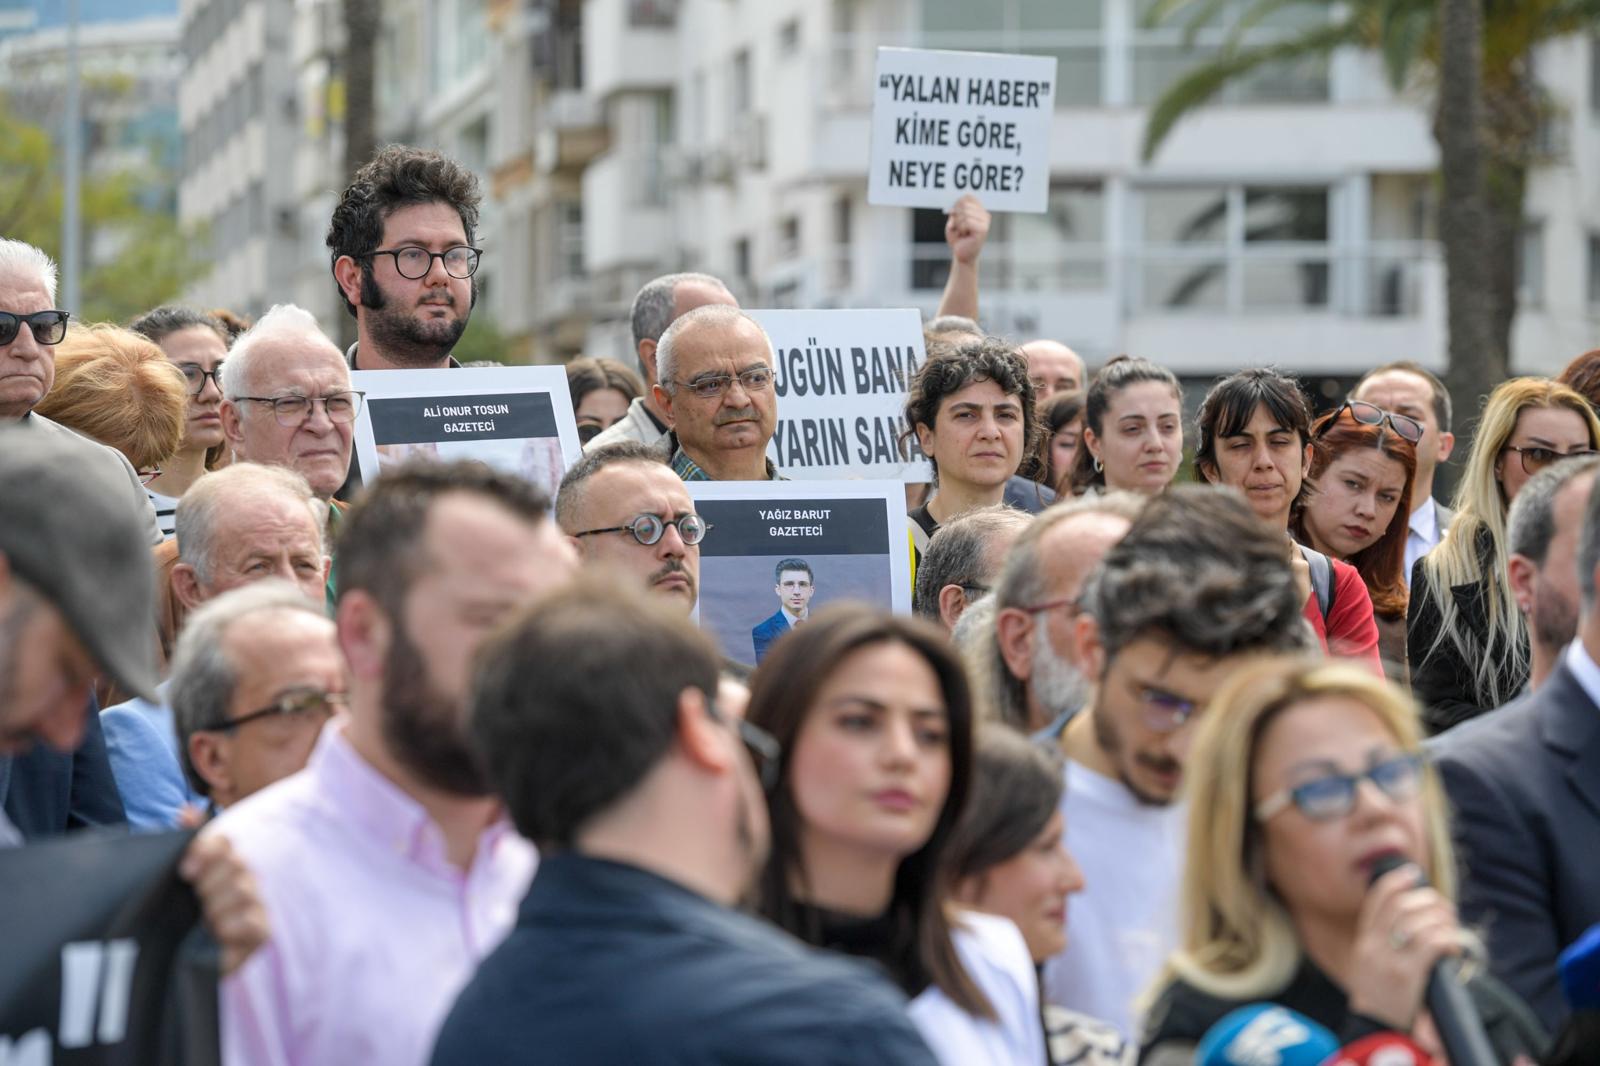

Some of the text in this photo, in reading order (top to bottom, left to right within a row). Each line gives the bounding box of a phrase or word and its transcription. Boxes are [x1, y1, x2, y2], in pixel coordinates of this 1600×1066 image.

[896, 111, 1022, 156] KİME GÖRE,
[889, 157, 1024, 192] NEYE GÖRE?
[775, 337, 846, 397] UGÜN
[423, 404, 509, 418] ALİ ONUR TOSUN
[443, 419, 495, 433] GAZETECİ
[773, 417, 850, 468] YARIN
[759, 508, 831, 520] YAĞIZ BARUT
[769, 524, 823, 536] GAZETECİ
